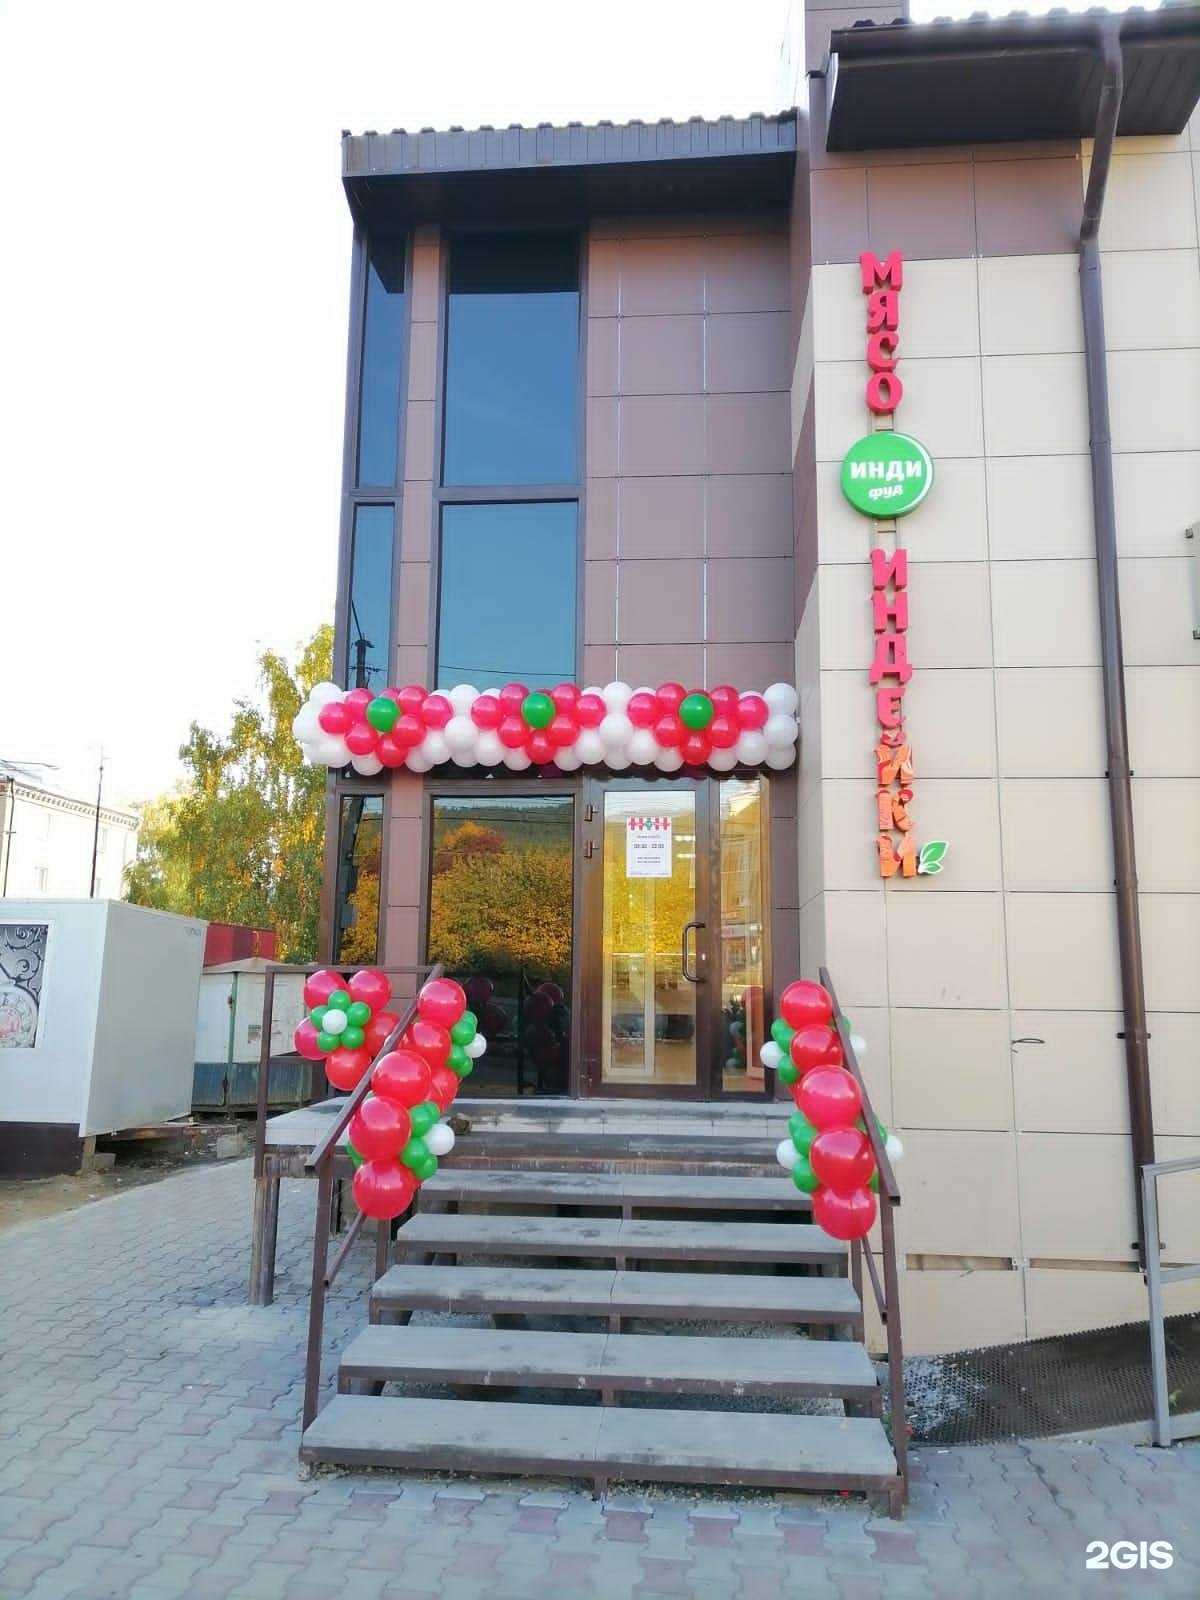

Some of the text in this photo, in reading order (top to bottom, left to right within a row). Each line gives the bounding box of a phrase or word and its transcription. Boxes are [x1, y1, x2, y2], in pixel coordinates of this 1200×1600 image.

[860, 251, 903, 415] МЯСО
[850, 460, 922, 482] ИНДИ
[868, 548, 917, 878] ИНДЕЙКИ
